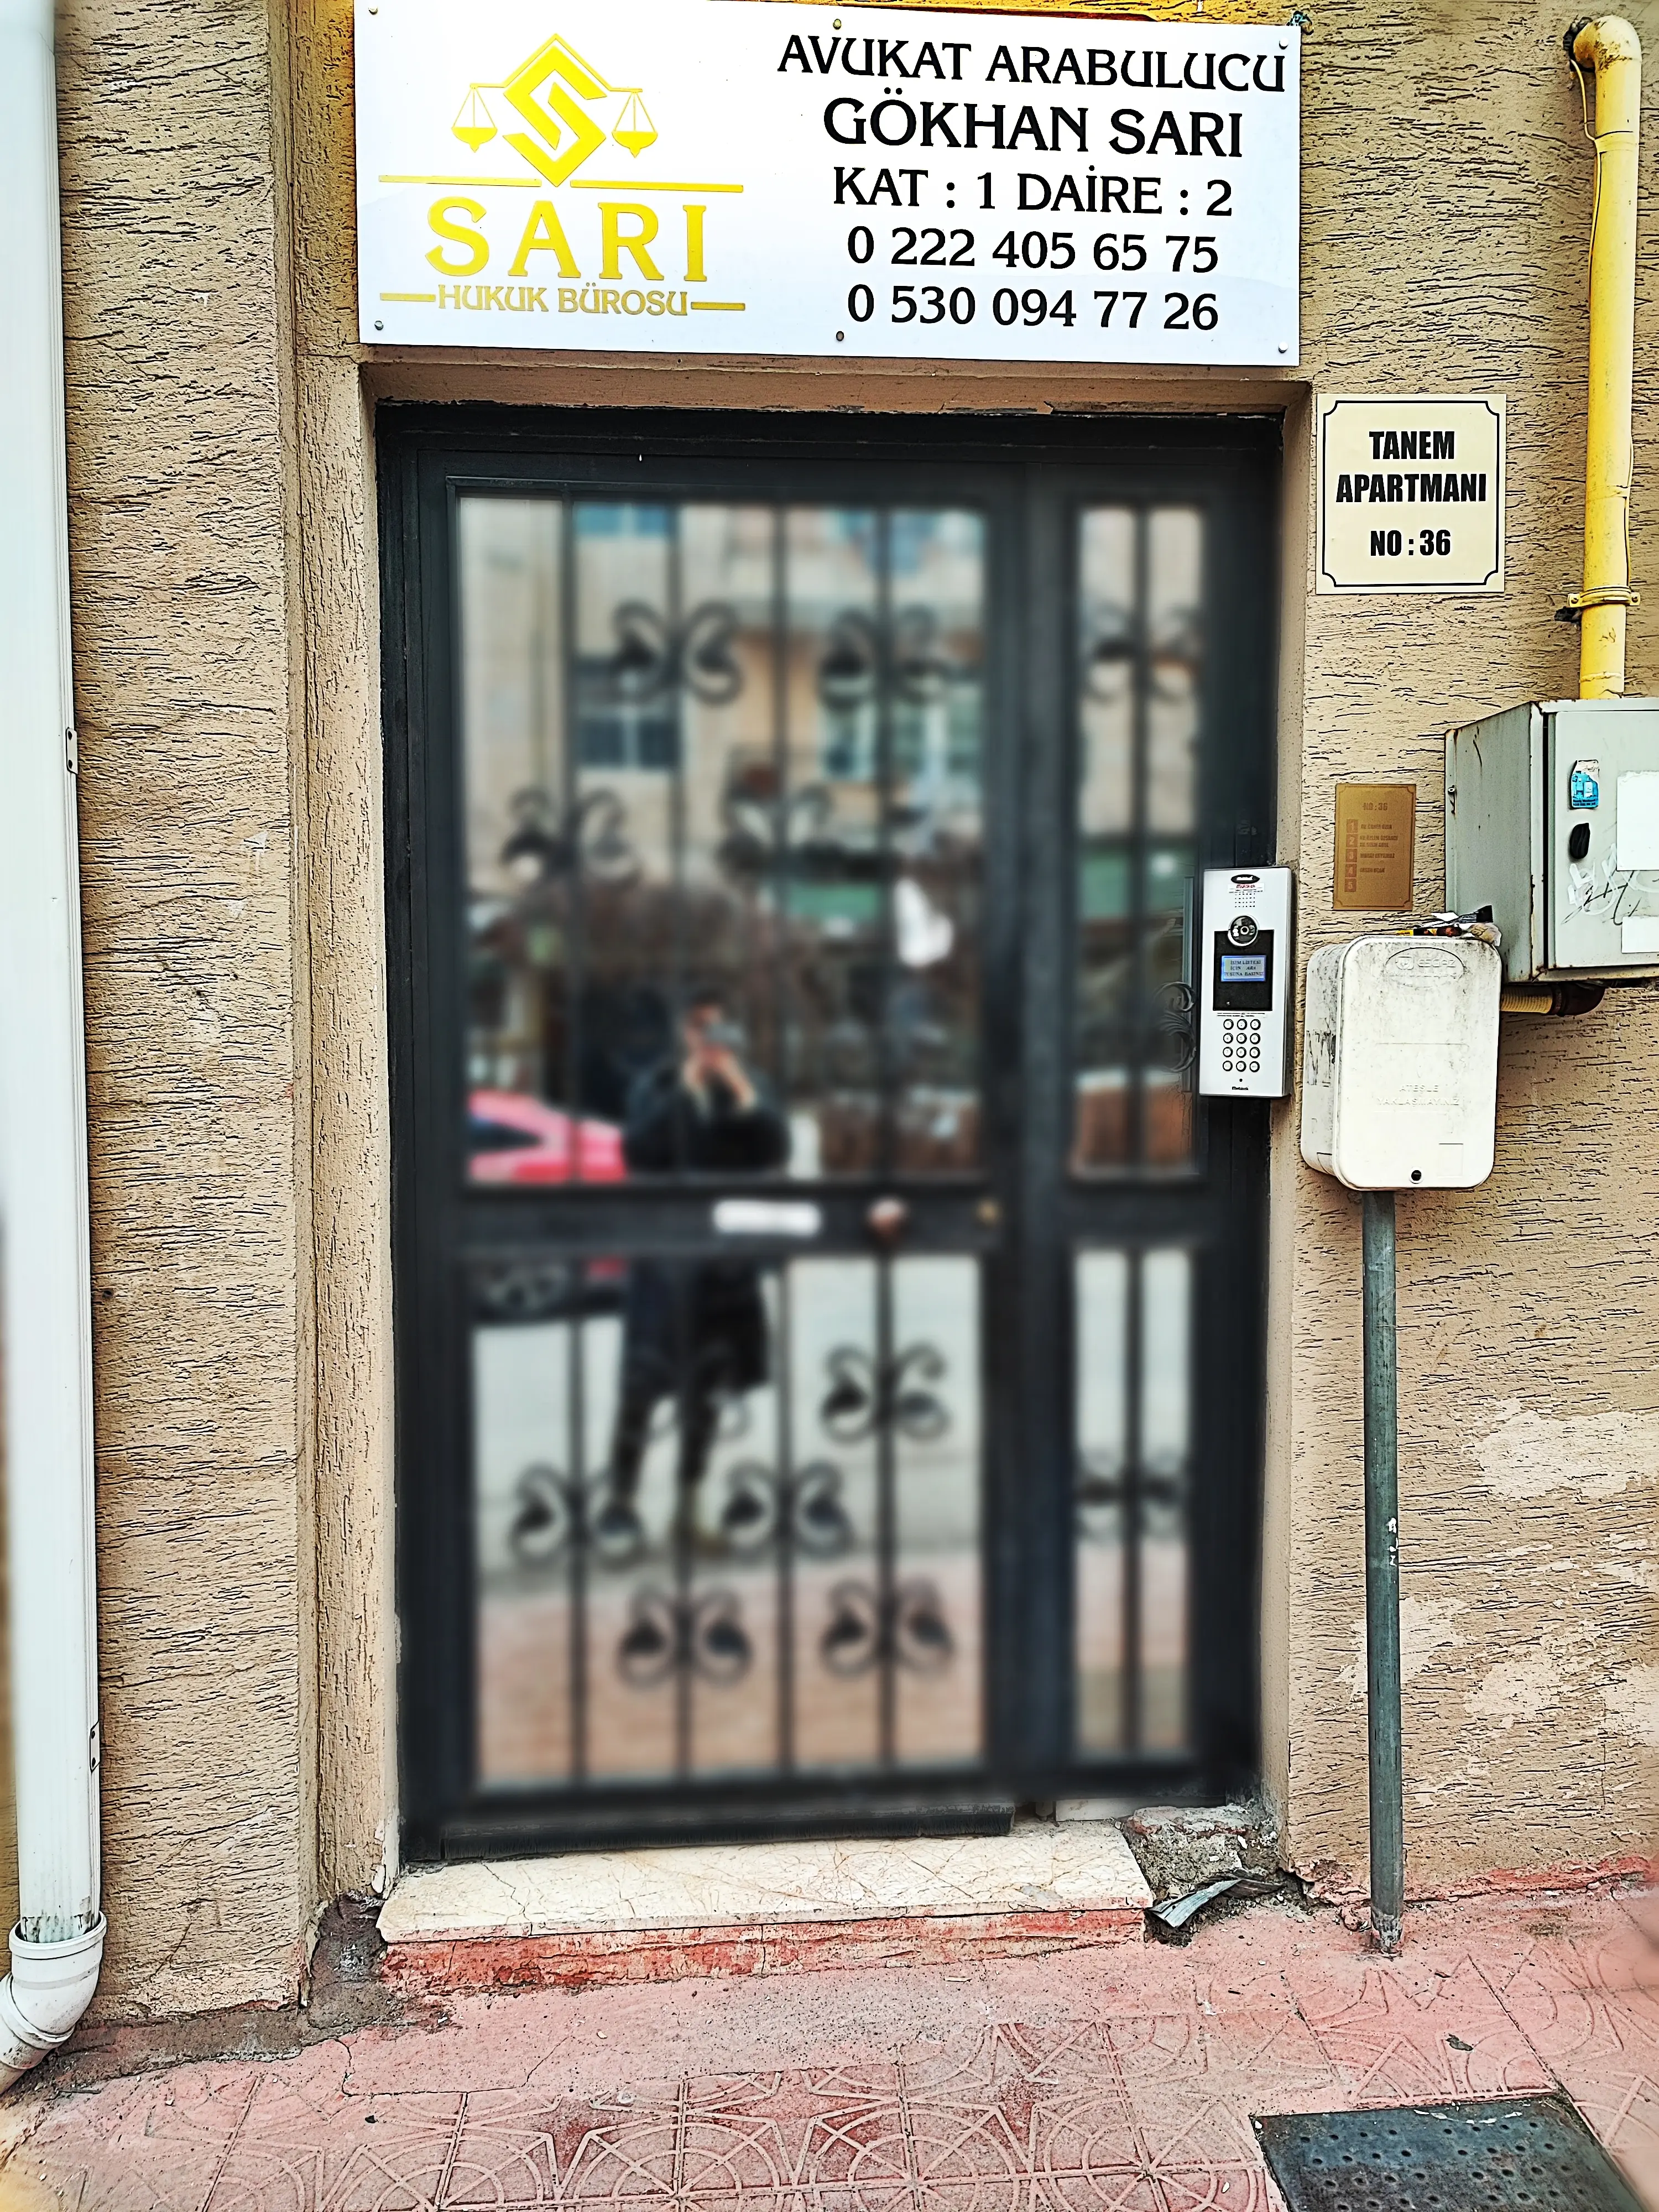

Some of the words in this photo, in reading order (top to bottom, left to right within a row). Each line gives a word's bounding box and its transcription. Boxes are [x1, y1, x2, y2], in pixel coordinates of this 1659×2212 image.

[777, 34, 972, 80] AVUKAT
[985, 45, 1285, 92] ARABULUCU
[823, 87, 1089, 152] GÖKHAN
[1108, 108, 1243, 158] SARI
[833, 166, 928, 207] KAT
[946, 182, 955, 208] :
[977, 172, 995, 210] 1
[1017, 165, 1162, 215] DAİRE
[1180, 189, 1188, 216] :
[1206, 179, 1232, 216] 2
[425, 196, 707, 282] SARI
[847, 226, 874, 264] 0
[891, 227, 975, 267] 222
[992, 231, 1076, 269] 405
[1093, 233, 1147, 271] 65
[1166, 235, 1218, 273] 75
[439, 284, 549, 312] HUKUK
[558, 282, 688, 316] BÜROSU
[847, 284, 874, 322] 0
[891, 285, 975, 325] 530
[993, 288, 1077, 327] 094
[1094, 290, 1147, 328] 77
[1164, 292, 1218, 331] 26
[1369, 431, 1455, 460] TANEM
[1335, 473, 1486, 503] APARTMANI
[1370, 529, 1402, 556] NO
[1420, 529, 1451, 556] 36
